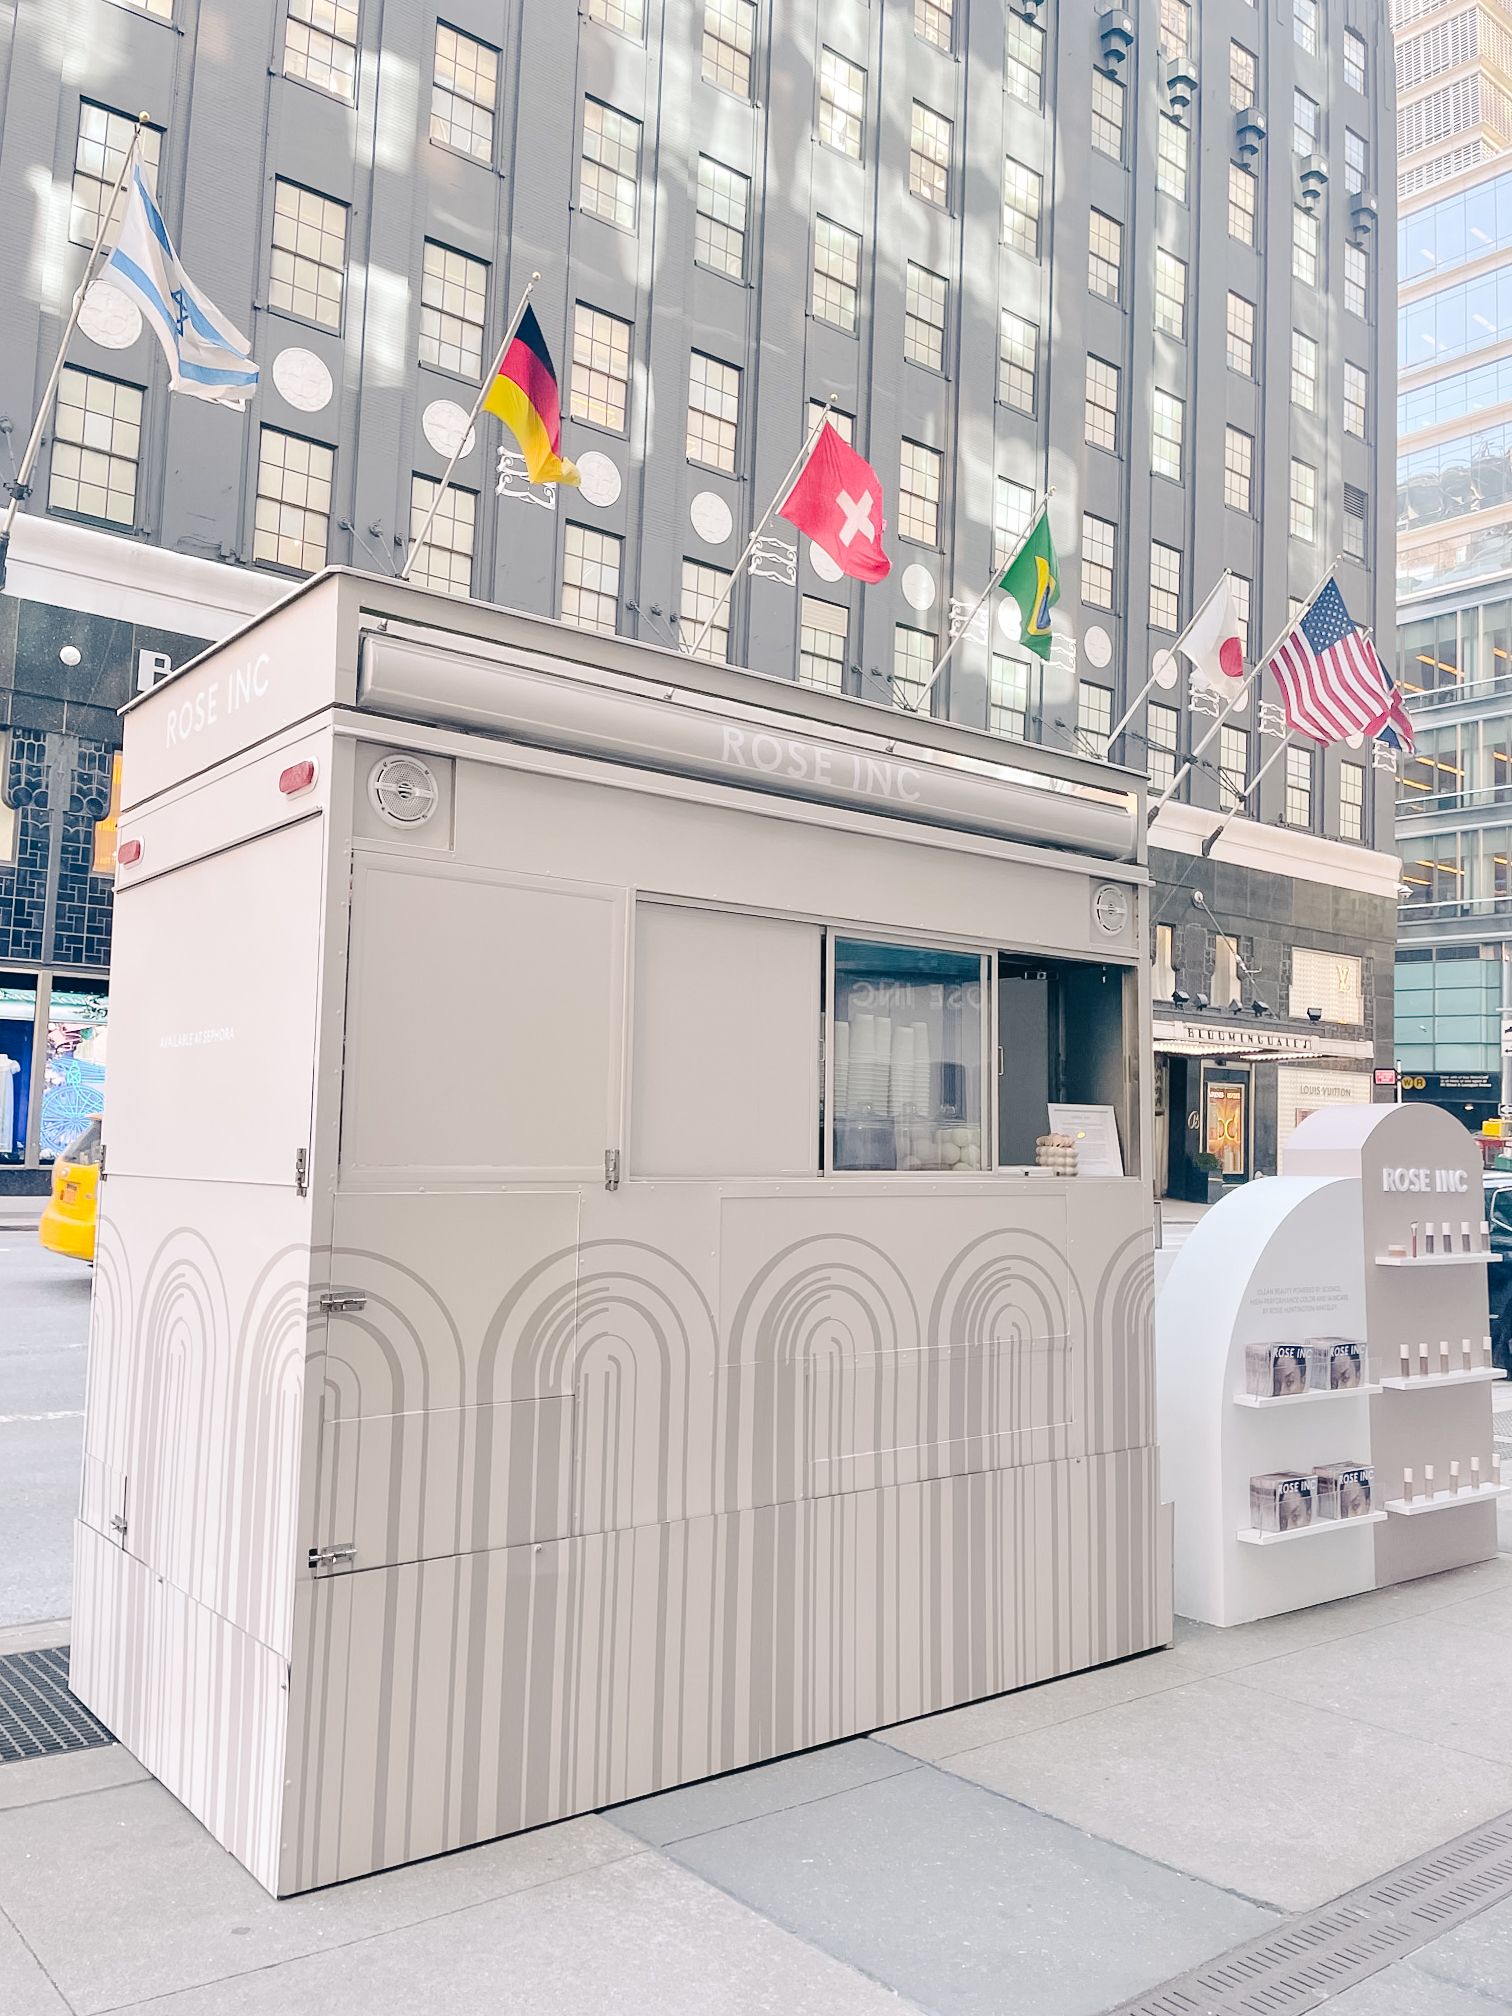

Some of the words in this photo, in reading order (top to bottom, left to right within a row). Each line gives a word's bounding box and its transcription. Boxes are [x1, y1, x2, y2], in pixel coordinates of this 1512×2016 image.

[166, 682, 219, 749] ROSE
[227, 653, 270, 714] INC
[721, 724, 832, 785] ROSE
[852, 756, 921, 802] INC
[1300, 1085, 1321, 1096] LOUIS
[1321, 1086, 1351, 1097] VUITTON
[1382, 1167, 1432, 1192] ROSE
[1435, 1169, 1468, 1193] INC
[1273, 1347, 1295, 1358] ROSE
[1297, 1348, 1313, 1359] INC
[1330, 1345, 1349, 1357] ROSE
[1339, 1472, 1358, 1485] ROSE
[1278, 1481, 1299, 1494] ROSE
